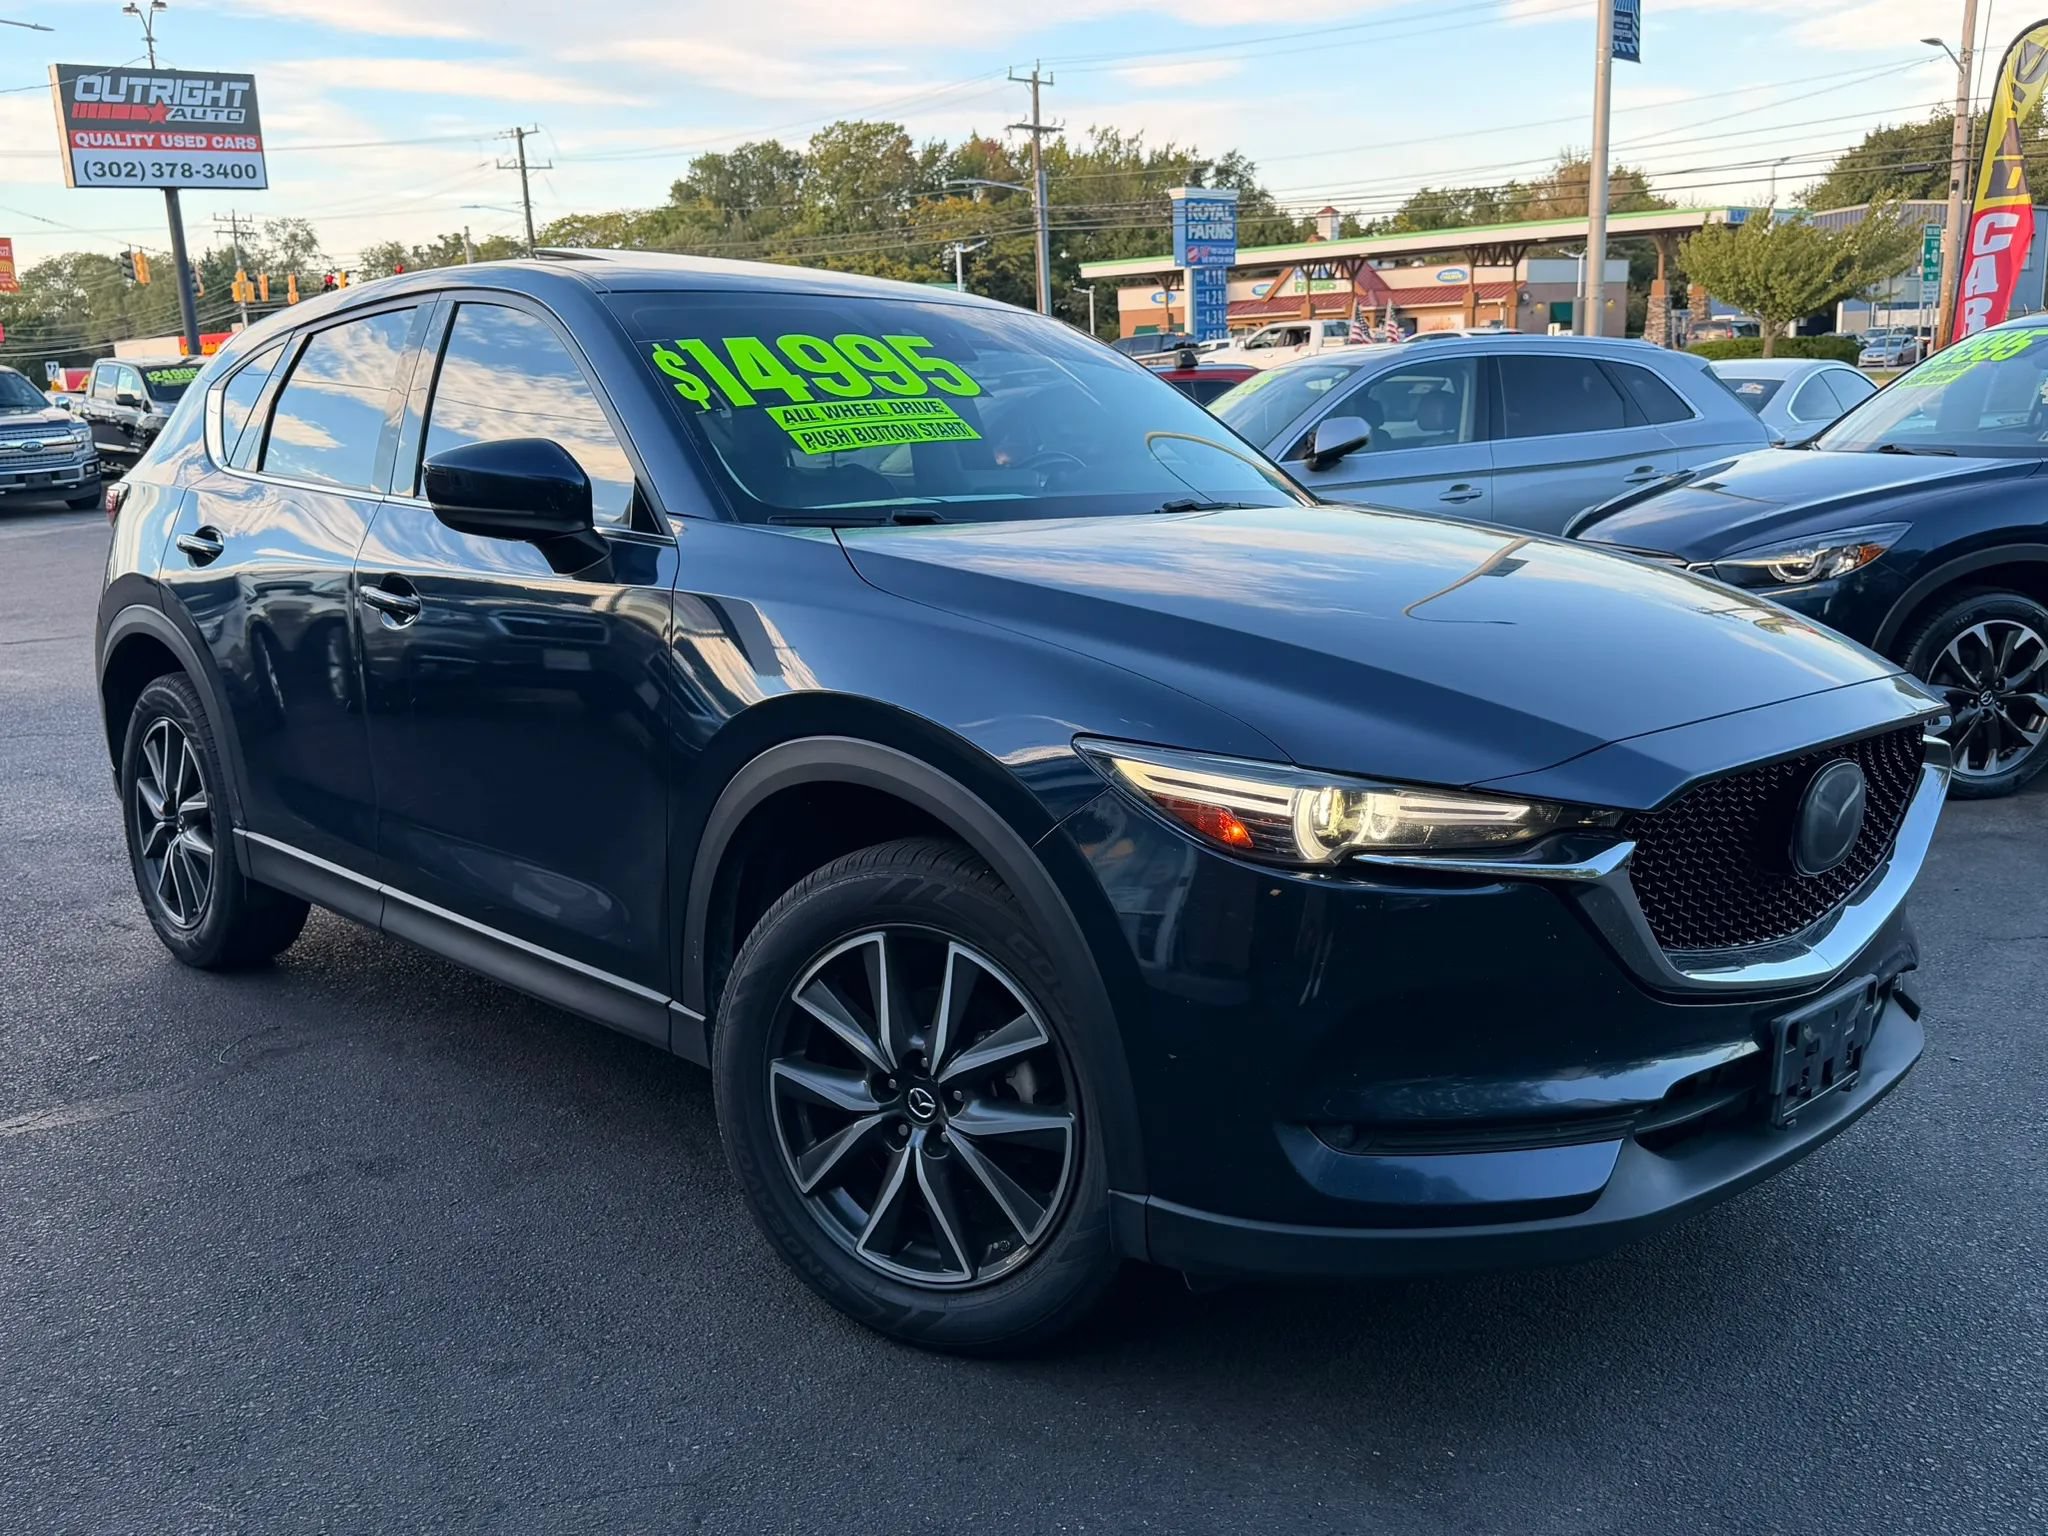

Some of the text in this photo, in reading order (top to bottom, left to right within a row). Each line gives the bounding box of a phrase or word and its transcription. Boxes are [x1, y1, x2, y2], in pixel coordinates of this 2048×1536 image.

[74, 74, 250, 107] OUTRIGHT
[170, 106, 244, 122] AUTO
[75, 132, 257, 150] QUALITY USED CARS
[83, 160, 257, 182] (302) 378-3400
[1187, 203, 1234, 221] ROYAL
[1187, 221, 1234, 240] FARMS
[652, 334, 981, 410] $14995
[783, 401, 945, 425] ALL WHEEL DRIVE
[802, 422, 971, 449] PUSH BUTTON START
